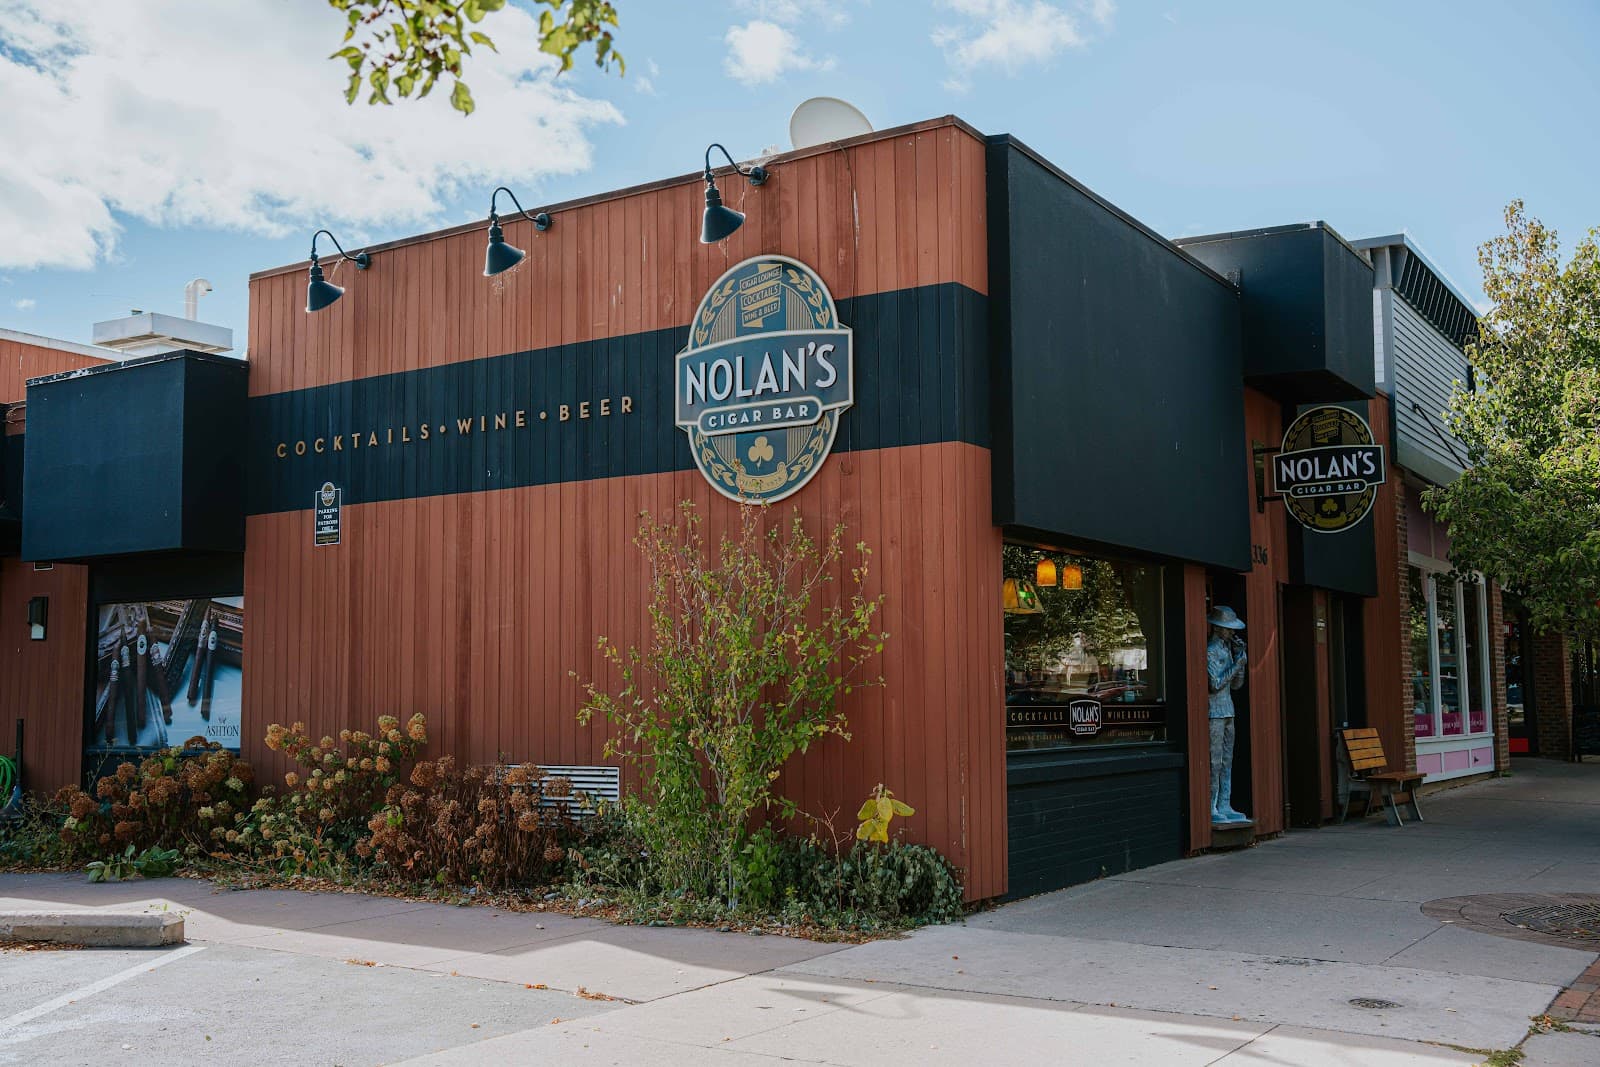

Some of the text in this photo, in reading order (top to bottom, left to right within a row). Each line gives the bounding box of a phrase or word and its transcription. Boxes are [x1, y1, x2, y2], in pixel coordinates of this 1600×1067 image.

[743, 284, 779, 306] COCKTAILS
[763, 302, 778, 314] BEER
[686, 341, 837, 405] NOLAN'S
[708, 404, 810, 428] CIGAR BAR
[276, 396, 633, 458] COCKTAILS WINE BEER
[1280, 450, 1376, 482] NOLAN'S
[1296, 482, 1360, 494] CIGAR BAR
[1011, 711, 1064, 721] COCKTAILS
[1072, 705, 1099, 722] NOLAN'S
[205, 724, 239, 737] ASHTON
